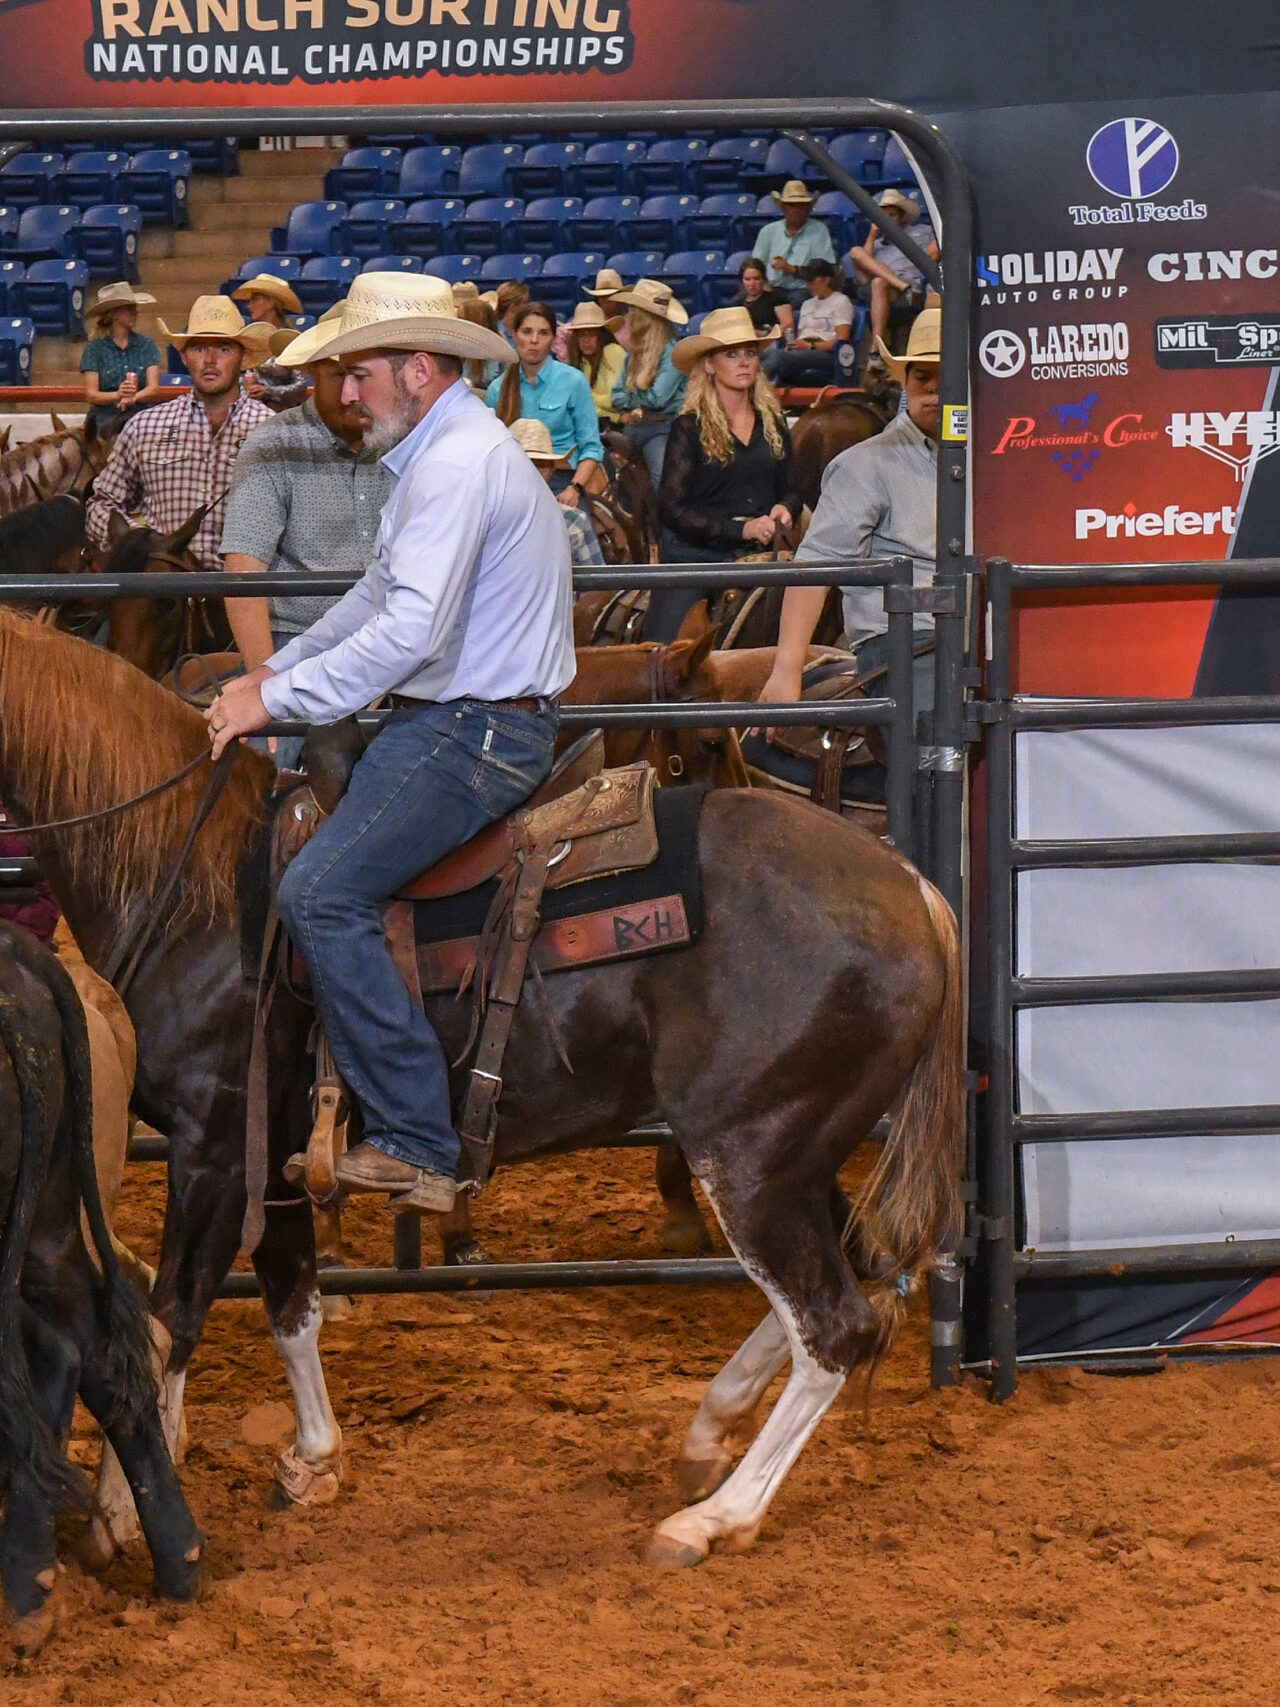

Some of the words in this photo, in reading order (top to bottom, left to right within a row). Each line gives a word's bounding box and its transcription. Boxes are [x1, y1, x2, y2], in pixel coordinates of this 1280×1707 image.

[100, 0, 324, 39] RANCH
[344, 0, 620, 32] SORTING
[93, 43, 289, 75] NATIONAL
[304, 36, 625, 75] CHAMPIONSHIPS
[1069, 203, 1132, 225] Total
[1136, 199, 1207, 223] Feeds
[976, 248, 1124, 288] HOLIDAY
[981, 290, 1037, 306] AUTO
[1052, 285, 1129, 301] GROUP
[1028, 322, 1129, 365] LAREDO
[1161, 325, 1208, 348] Mil
[1238, 325, 1280, 350] Sp
[1236, 346, 1273, 360] Liner
[1030, 362, 1129, 381] CONVERSIONS
[991, 417, 1100, 454] Professional's
[1102, 414, 1159, 448] Choice
[1172, 411, 1280, 447] HYE
[1075, 503, 1236, 540] Priefert
